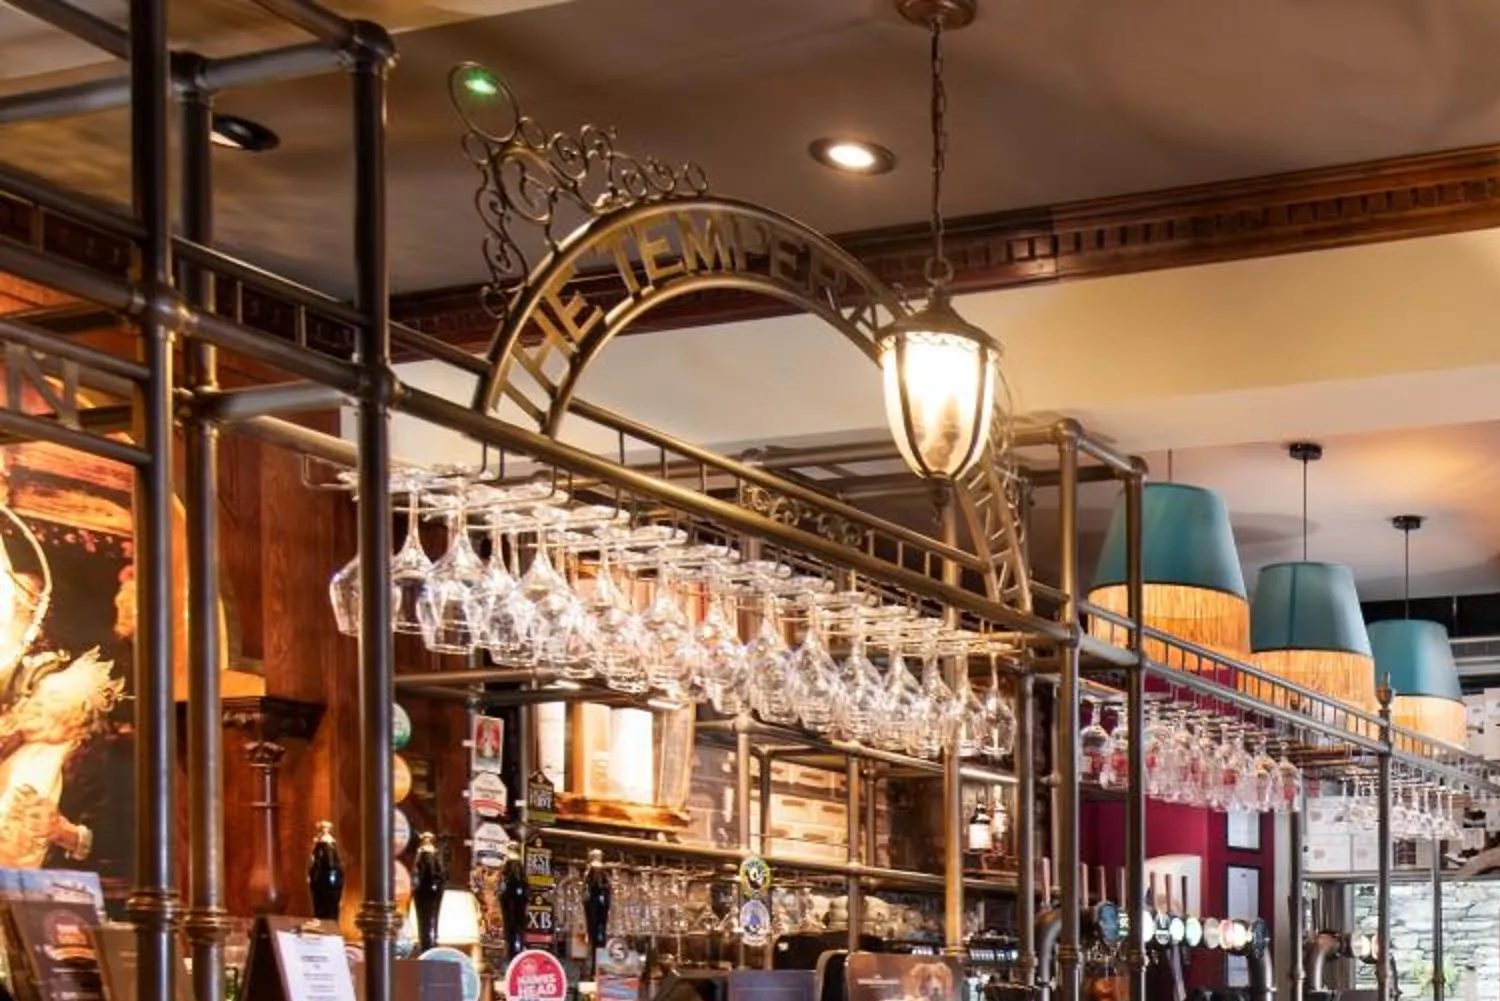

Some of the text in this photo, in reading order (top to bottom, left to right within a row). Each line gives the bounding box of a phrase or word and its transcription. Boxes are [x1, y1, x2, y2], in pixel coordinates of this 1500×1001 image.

[492, 270, 602, 422] THE
[606, 210, 884, 336] TEMPERA
[527, 911, 552, 929] XB
